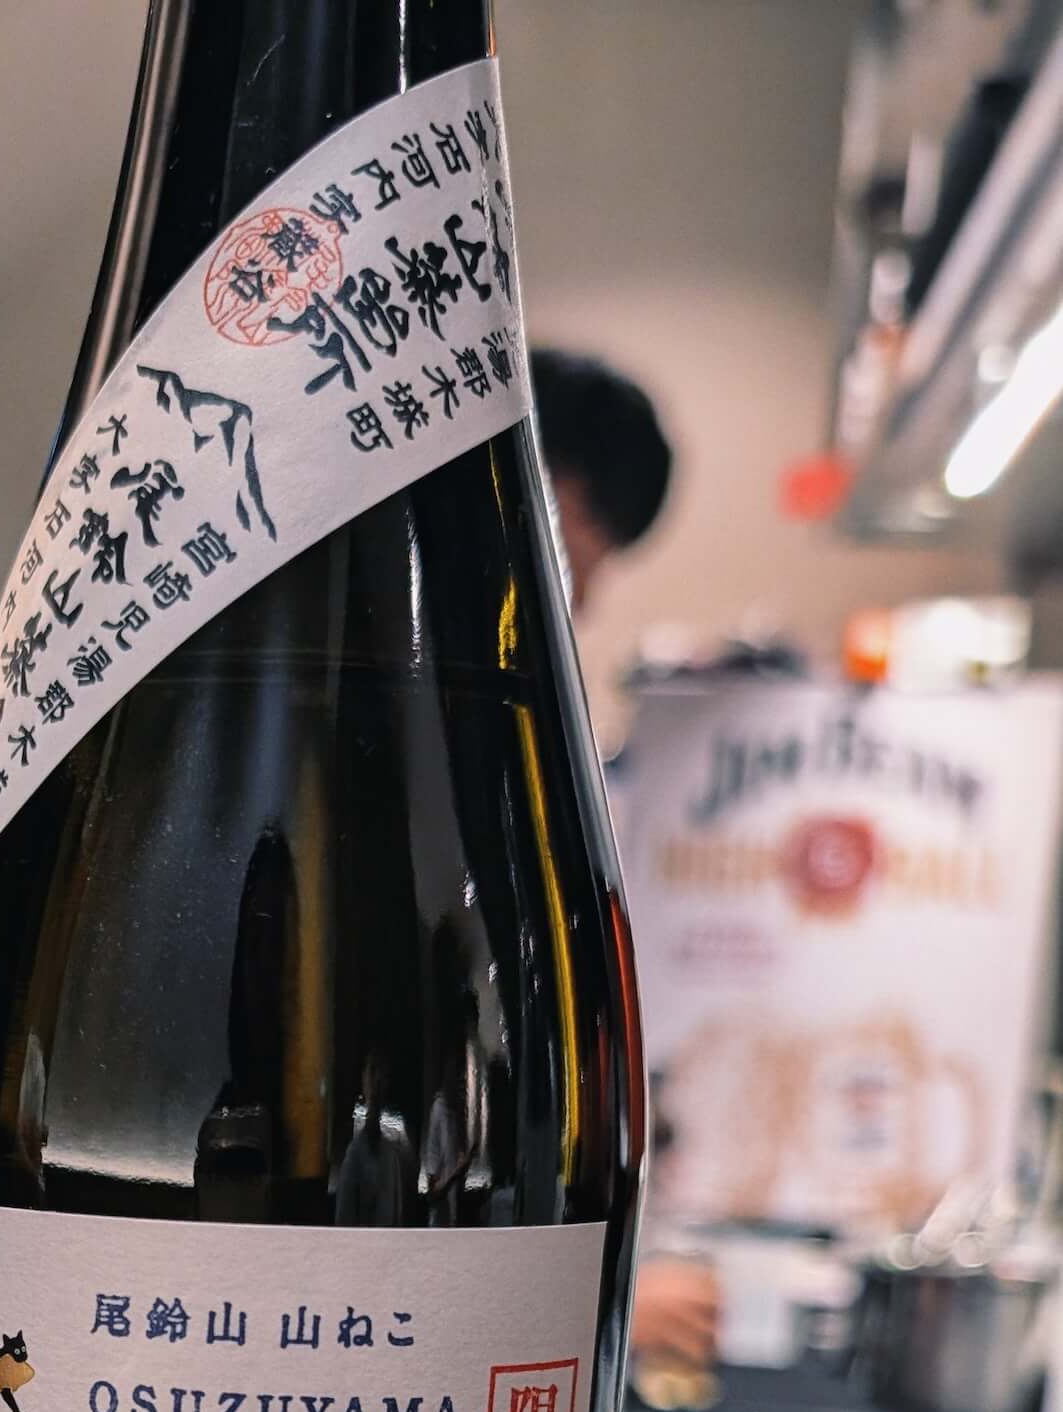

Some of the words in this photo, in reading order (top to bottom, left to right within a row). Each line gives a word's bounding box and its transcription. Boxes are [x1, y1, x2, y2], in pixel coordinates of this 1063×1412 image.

[88, 1293, 248, 1348] 尾鈴山
[279, 1303, 418, 1350] 山ねこ
